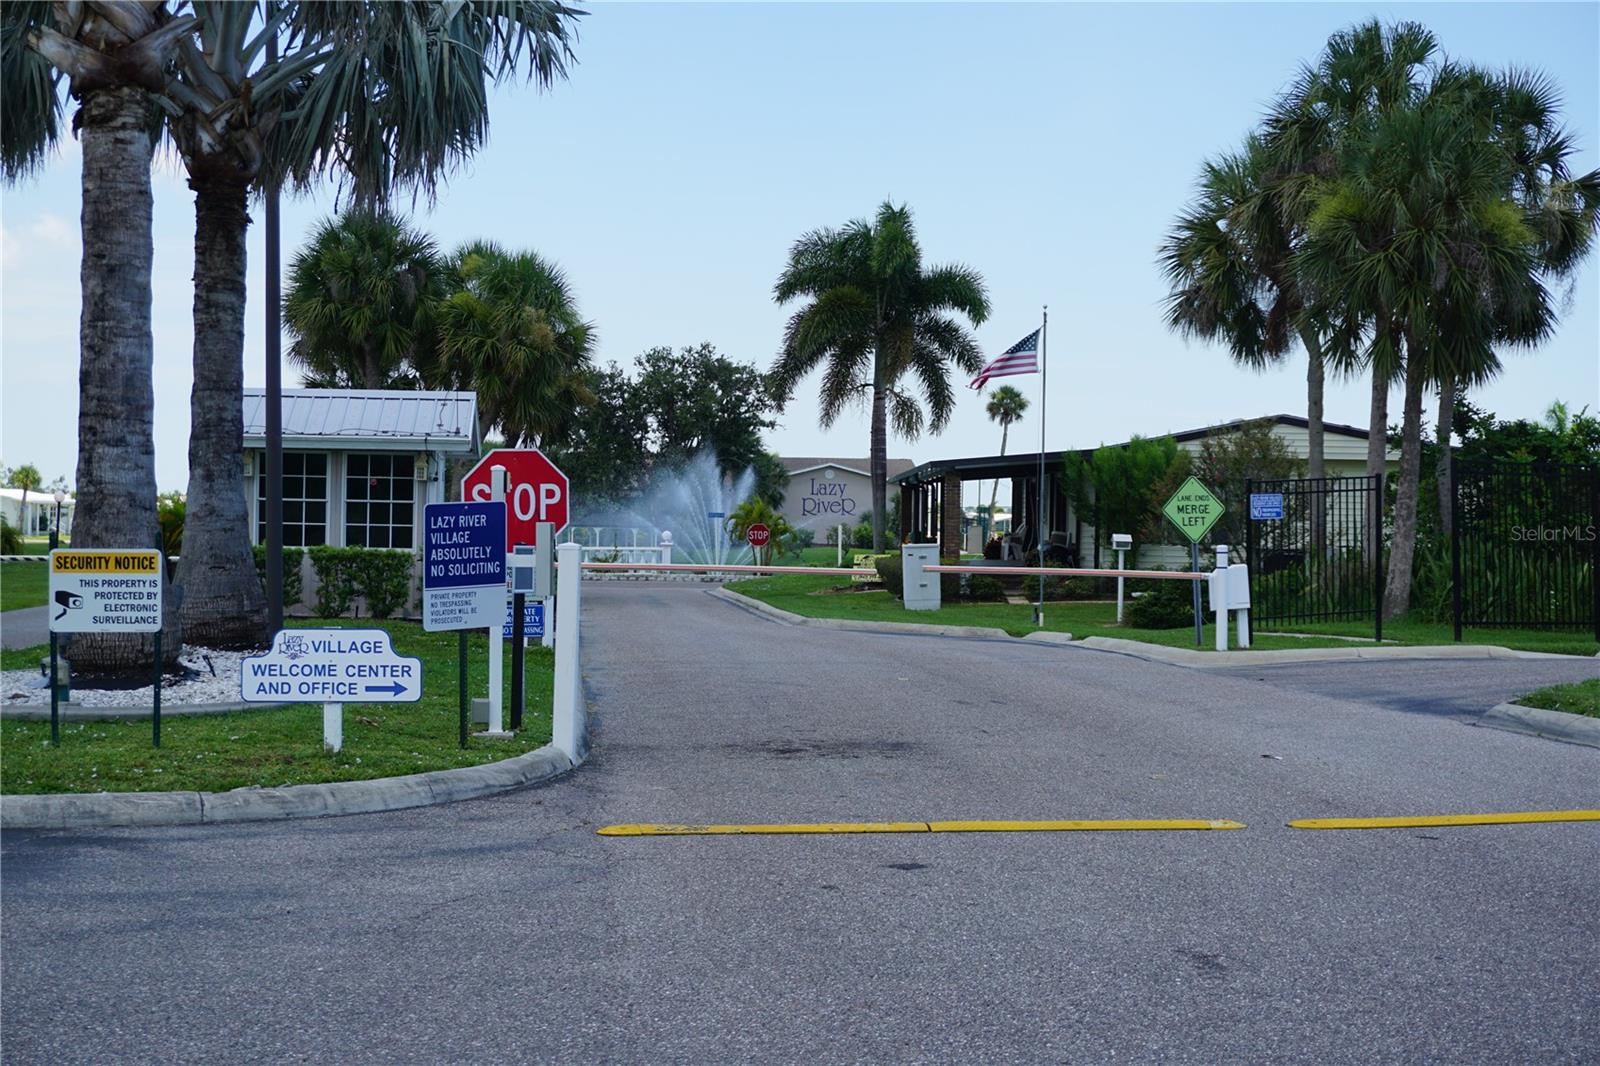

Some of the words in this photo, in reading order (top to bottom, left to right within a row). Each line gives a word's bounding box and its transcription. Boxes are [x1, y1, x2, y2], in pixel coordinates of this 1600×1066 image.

[810, 478, 847, 498] Lazy
[472, 483, 561, 521] SOP
[1177, 504, 1210, 514] MERGE
[431, 516, 455, 528] LAZY
[459, 514, 486, 528] RIVER
[1182, 516, 1206, 526] LEFT
[430, 531, 470, 544] VILLAGE
[749, 530, 768, 540] STOP
[430, 546, 492, 560] ABSOLUTELY
[56, 556, 111, 570] SECURITY
[115, 556, 156, 570] NOTICE
[431, 564, 444, 576] NO
[448, 562, 500, 576] SOLICITING
[79, 580, 99, 588] THIS
[102, 580, 147, 588] PROPERTY
[149, 580, 158, 588] IS
[94, 592, 144, 600] PROTECTED
[147, 592, 158, 600] BY
[104, 604, 158, 612] ELECTRONIC
[430, 608, 456, 616] VIOLATORS
[92, 616, 158, 624] SURVEILLANCE
[430, 616, 462, 624] PROSECUTED
[311, 640, 383, 654] VILLAGE
[252, 664, 337, 676] WELCOME
[345, 665, 412, 678] CENTER
[256, 682, 292, 694] AND
[298, 682, 358, 695] OFFICE
